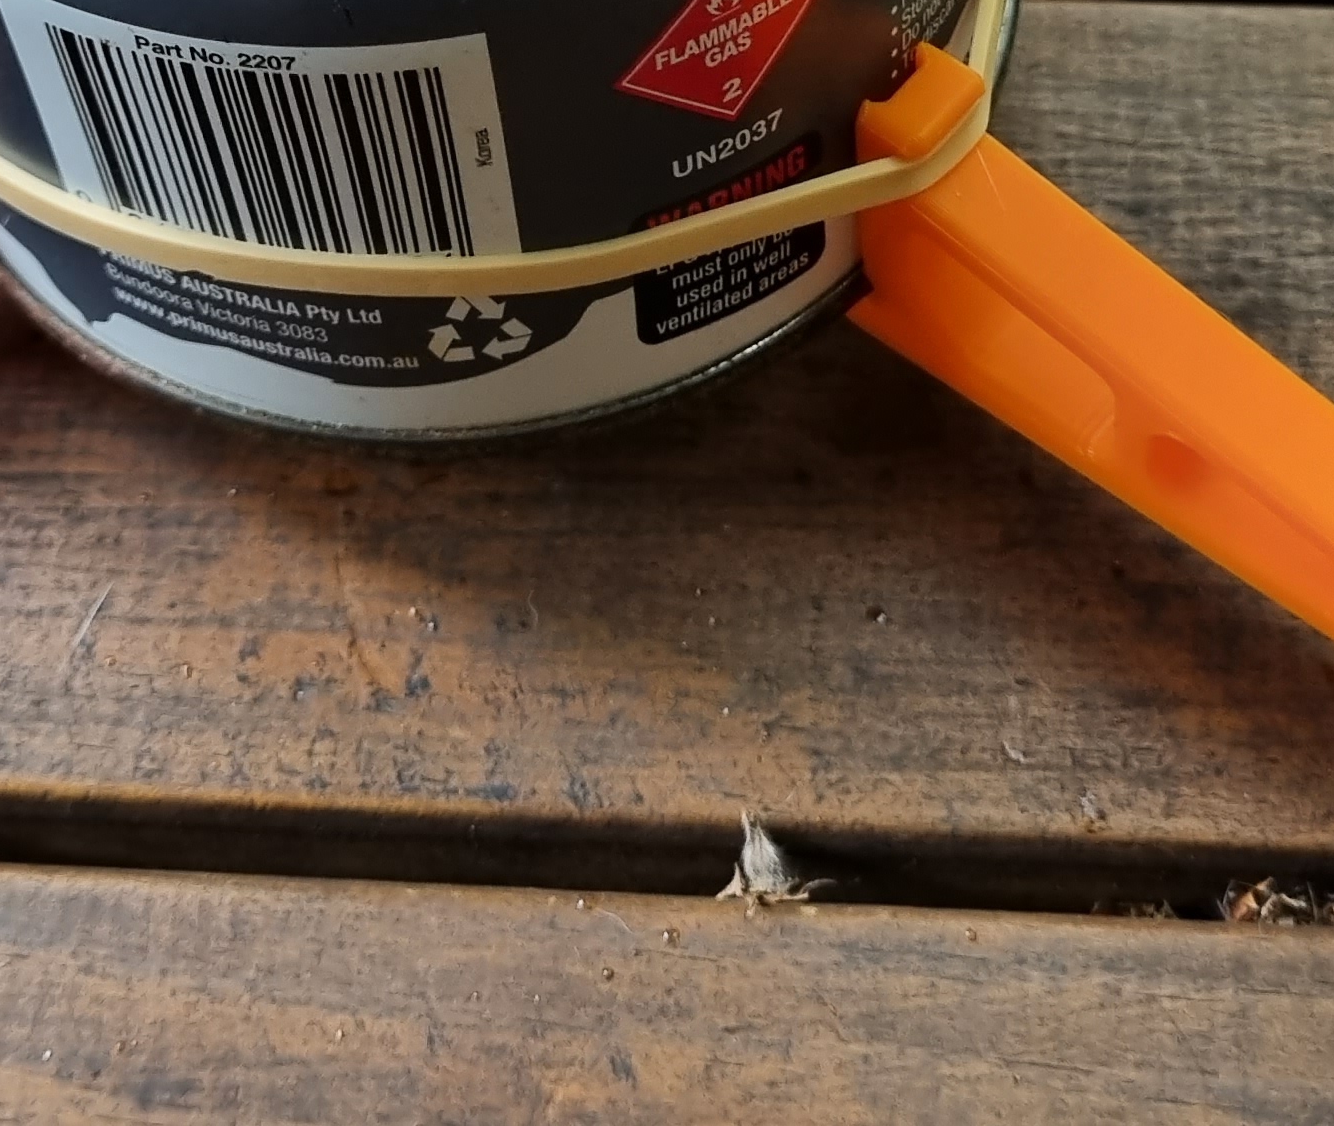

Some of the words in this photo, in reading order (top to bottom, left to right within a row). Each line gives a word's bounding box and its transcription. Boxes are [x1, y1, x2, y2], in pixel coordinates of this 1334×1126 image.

[134, 34, 183, 58] Part
[188, 45, 231, 66] No.
[237, 52, 297, 71] 2207
[704, 30, 752, 68] GAS
[902, 14, 919, 53] Do
[722, 76, 743, 103] 2
[672, 107, 783, 178] UN2037
[672, 256, 723, 291] must
[728, 234, 768, 267] only
[677, 275, 724, 308] used
[730, 267, 748, 285] in
[753, 240, 791, 275] well
[180, 275, 302, 317] AUSTRALIA
[306, 303, 340, 326] Pty
[347, 307, 383, 325] Ltd
[655, 281, 753, 335] ventilated
[758, 251, 809, 294] areas
[111, 285, 420, 370] www.primusaustralia.com.au
[195, 298, 271, 334] Victoria
[276, 319, 329, 343] 3083
